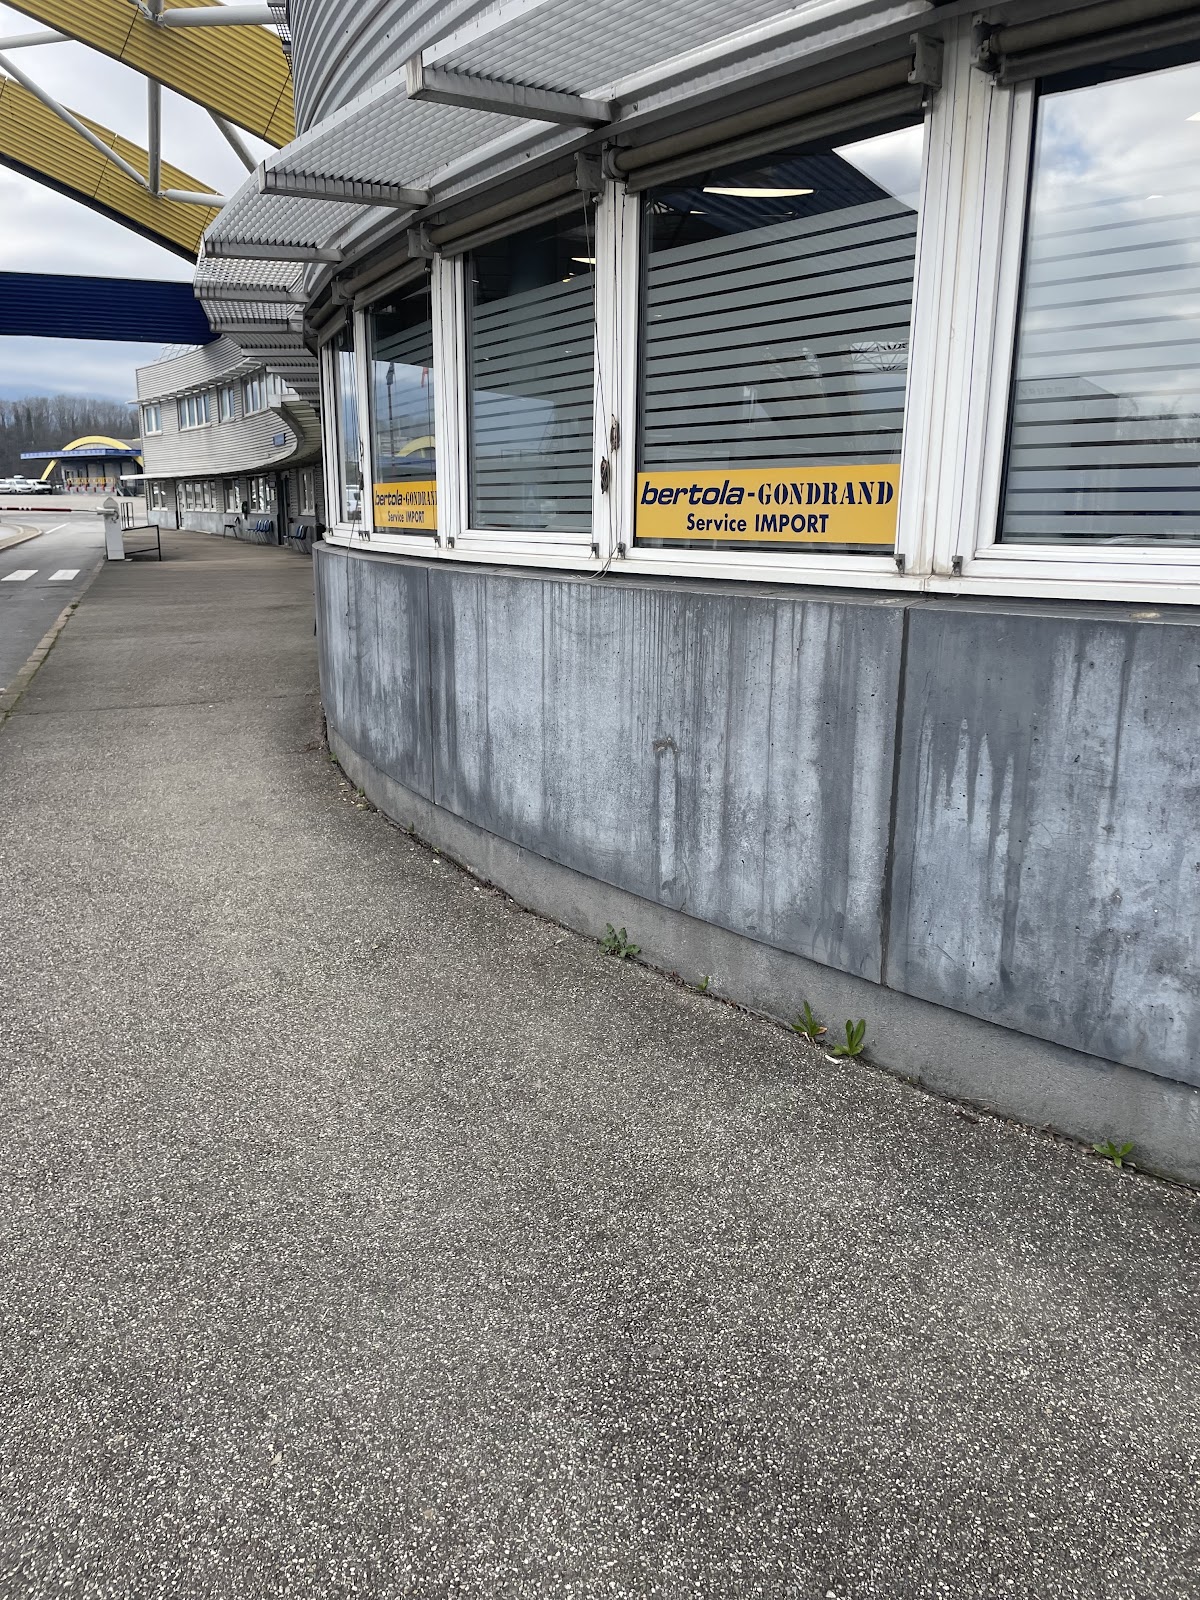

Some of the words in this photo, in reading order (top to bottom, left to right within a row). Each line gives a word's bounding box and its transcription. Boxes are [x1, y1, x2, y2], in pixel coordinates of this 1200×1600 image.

[640, 479, 894, 506] bertola-GONDRAND
[387, 510, 404, 523] Service
[406, 510, 425, 523] IMPORT
[687, 512, 747, 533] Service
[755, 513, 829, 533] IMPORT
